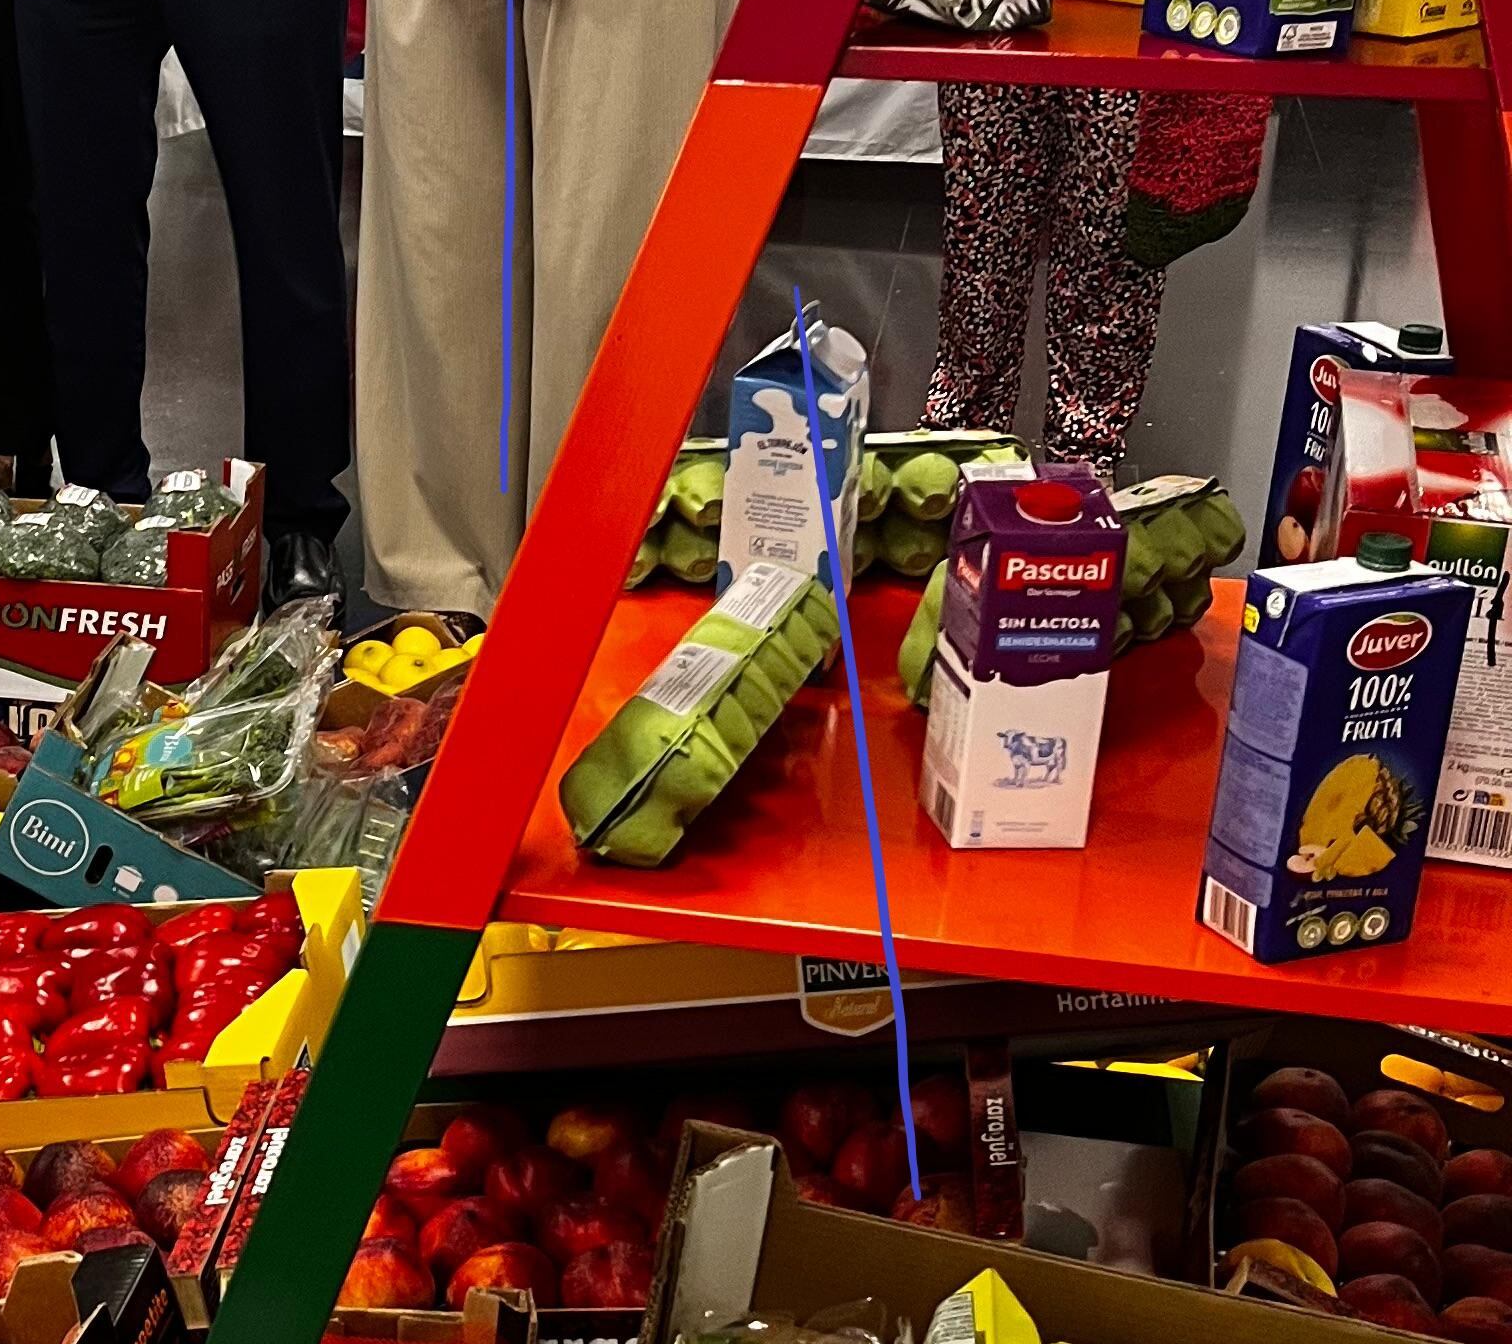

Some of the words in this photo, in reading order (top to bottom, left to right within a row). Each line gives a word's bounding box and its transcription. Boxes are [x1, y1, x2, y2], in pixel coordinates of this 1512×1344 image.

[1095, 515, 1121, 529] 1L
[1006, 557, 1110, 581] Pascual
[998, 617, 1026, 629] SIN
[1029, 617, 1100, 630] LACTOSA
[1355, 627, 1424, 659] Juver
[1346, 673, 1415, 711] 100%
[1341, 715, 1403, 742] FRUTA
[21, 815, 76, 858] Bimi
[981, 1097, 1017, 1167] zaragüel
[204, 1136, 248, 1206] zaragüel
